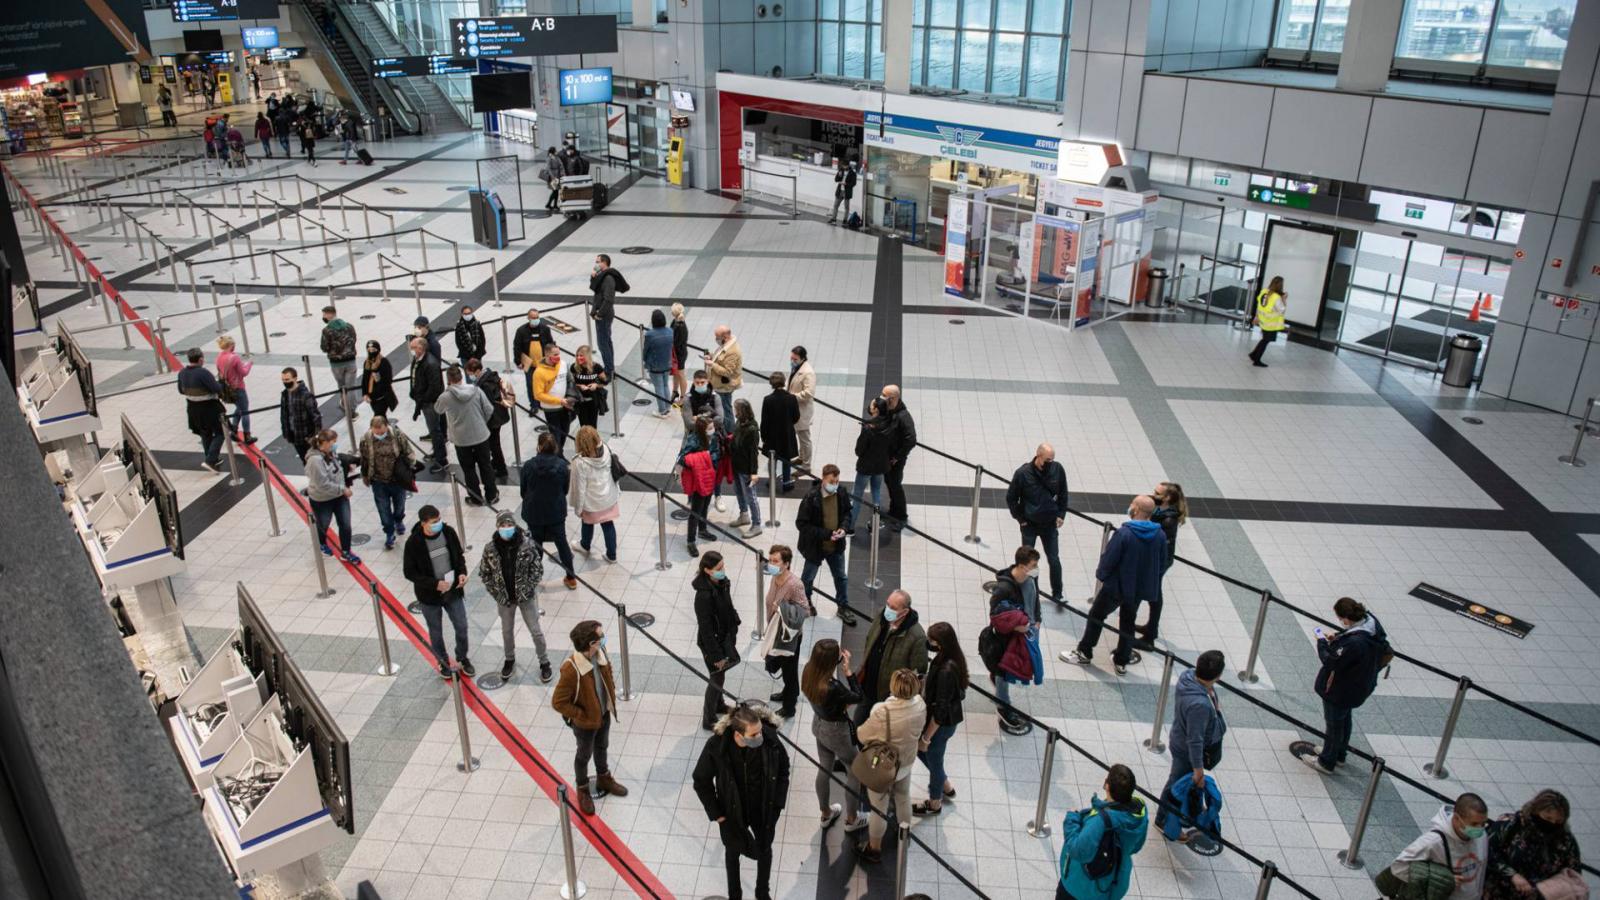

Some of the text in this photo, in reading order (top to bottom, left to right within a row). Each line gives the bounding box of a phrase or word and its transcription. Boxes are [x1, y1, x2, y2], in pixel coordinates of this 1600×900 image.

[565, 75, 574, 84] 10
[580, 74, 593, 83] 100
[1030, 160, 1049, 171] TICKET
